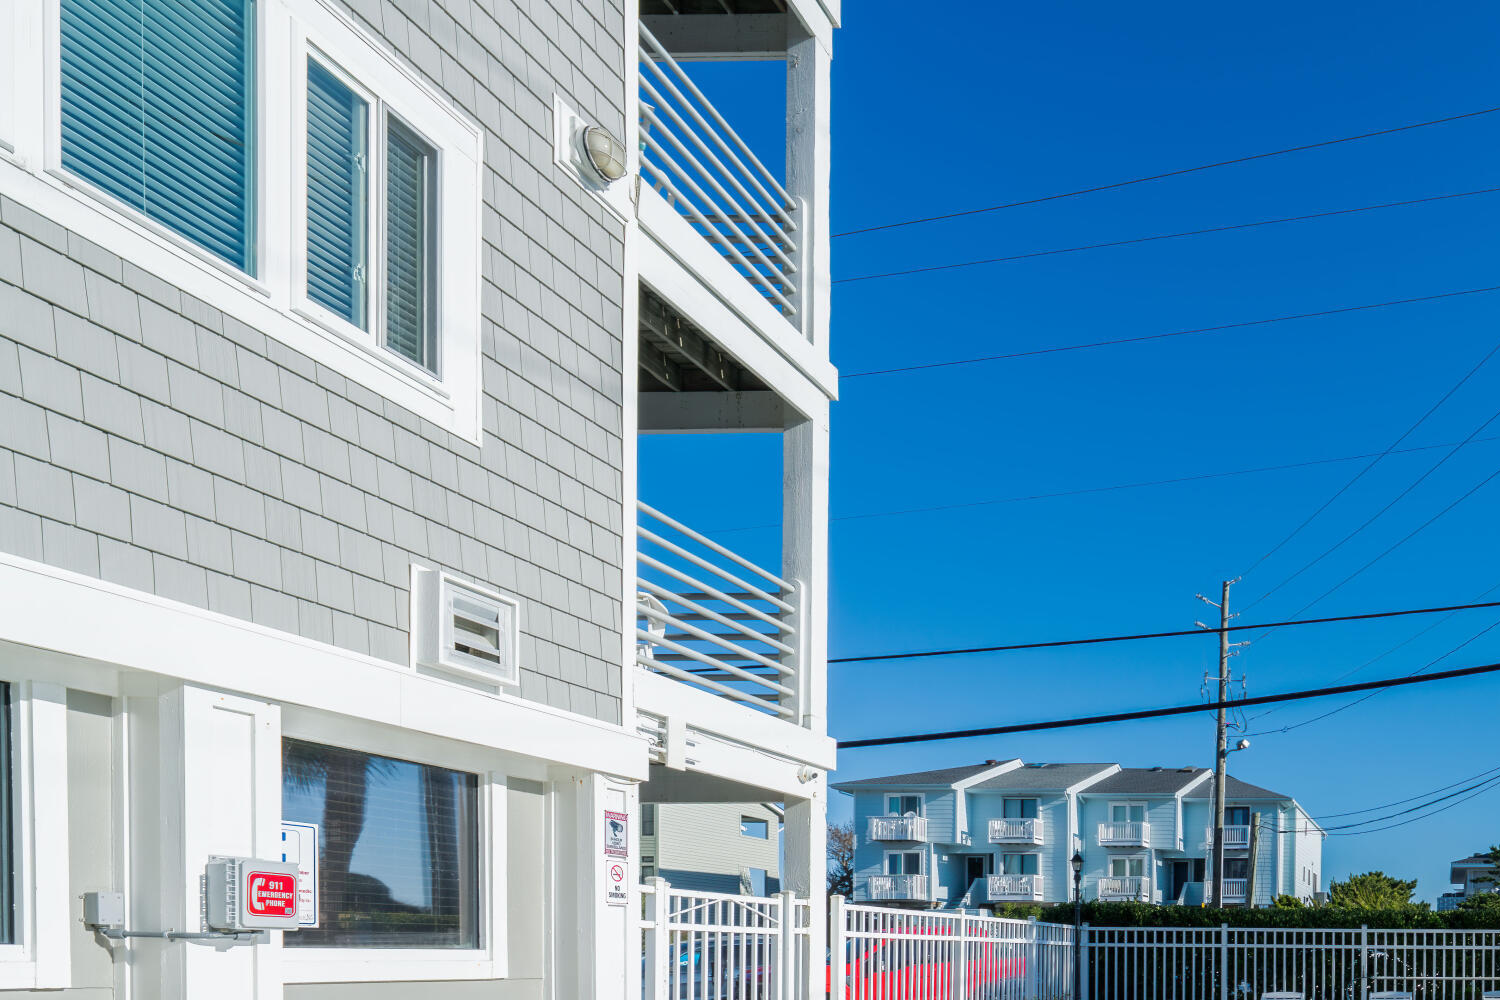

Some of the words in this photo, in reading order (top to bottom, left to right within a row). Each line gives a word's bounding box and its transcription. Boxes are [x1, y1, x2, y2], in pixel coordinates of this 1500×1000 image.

[268, 881, 283, 890] 911
[257, 890, 293, 899] EMERGENCY
[265, 899, 285, 907] PHONE
